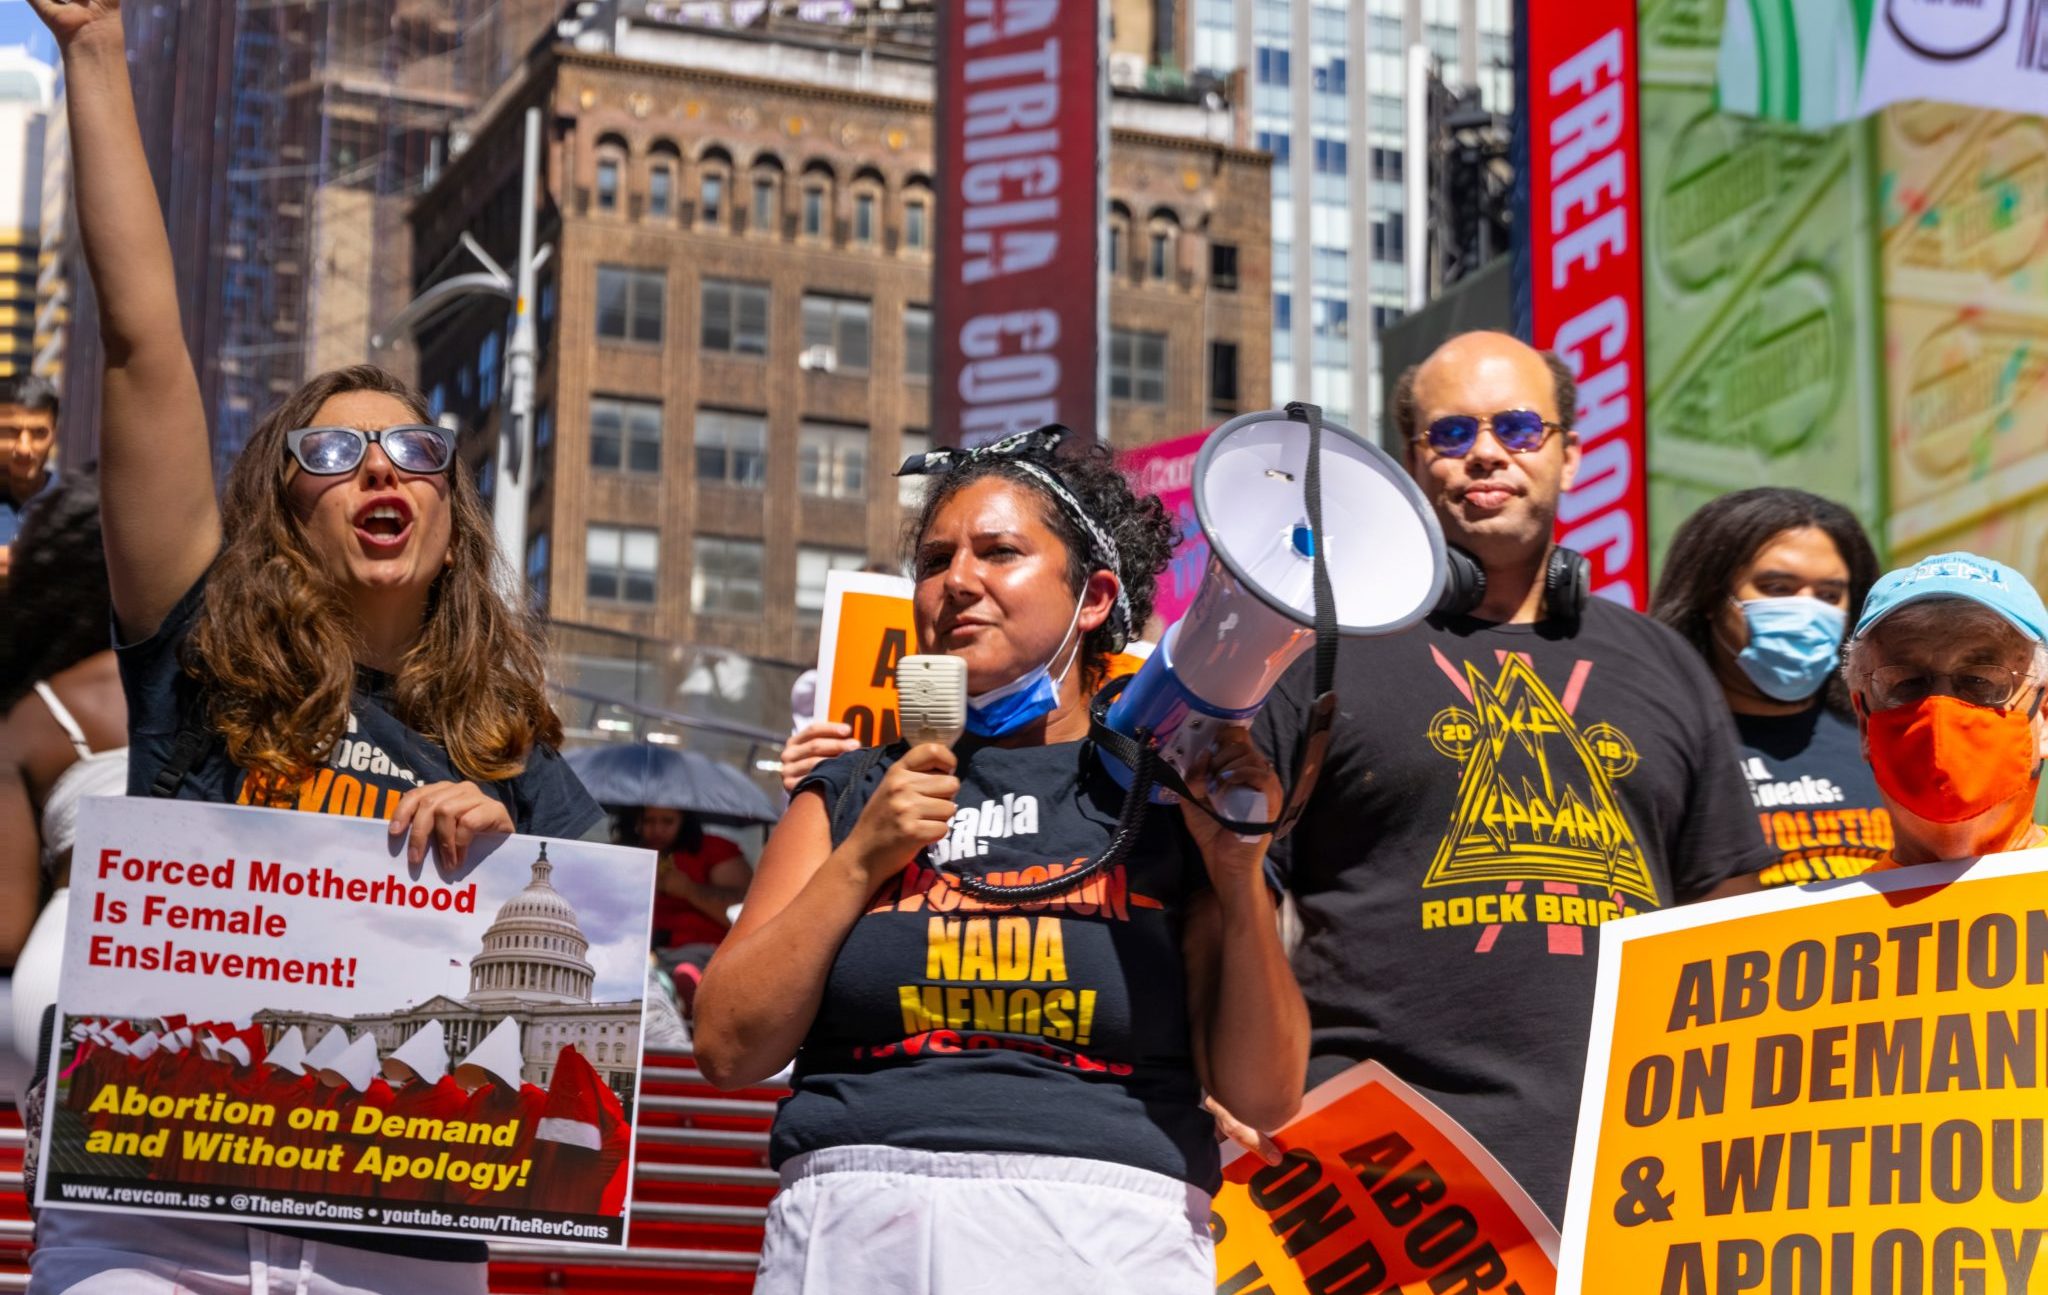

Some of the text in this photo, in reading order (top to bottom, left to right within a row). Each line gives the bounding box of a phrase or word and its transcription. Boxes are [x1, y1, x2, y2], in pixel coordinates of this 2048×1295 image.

[1549, 27, 1634, 609] FREE CHOC
[1442, 724, 1473, 742] 20
[1596, 739, 1623, 760] 18
[946, 793, 1039, 838] abla
[1750, 775, 1845, 807] peaks:
[98, 848, 477, 914] Forced Motherhood
[93, 892, 287, 938] Is Female
[1422, 894, 1528, 930] ROCK
[88, 935, 357, 989] Enslavement!
[926, 916, 1068, 982] NADA
[898, 985, 1097, 1046] MENOS!
[1624, 1008, 2048, 1128] ON DEMAN
[87, 1083, 519, 1147] Abortion on Demand
[85, 1130, 532, 1192] and Without Apology!
[1612, 1155, 1676, 1228] &
[61, 1182, 609, 1239] www.revcom.us @TheRevComs youtube.com/TheRevComs
[1248, 1147, 1355, 1259] ON
[1659, 1226, 2048, 1295] APOLOGY
